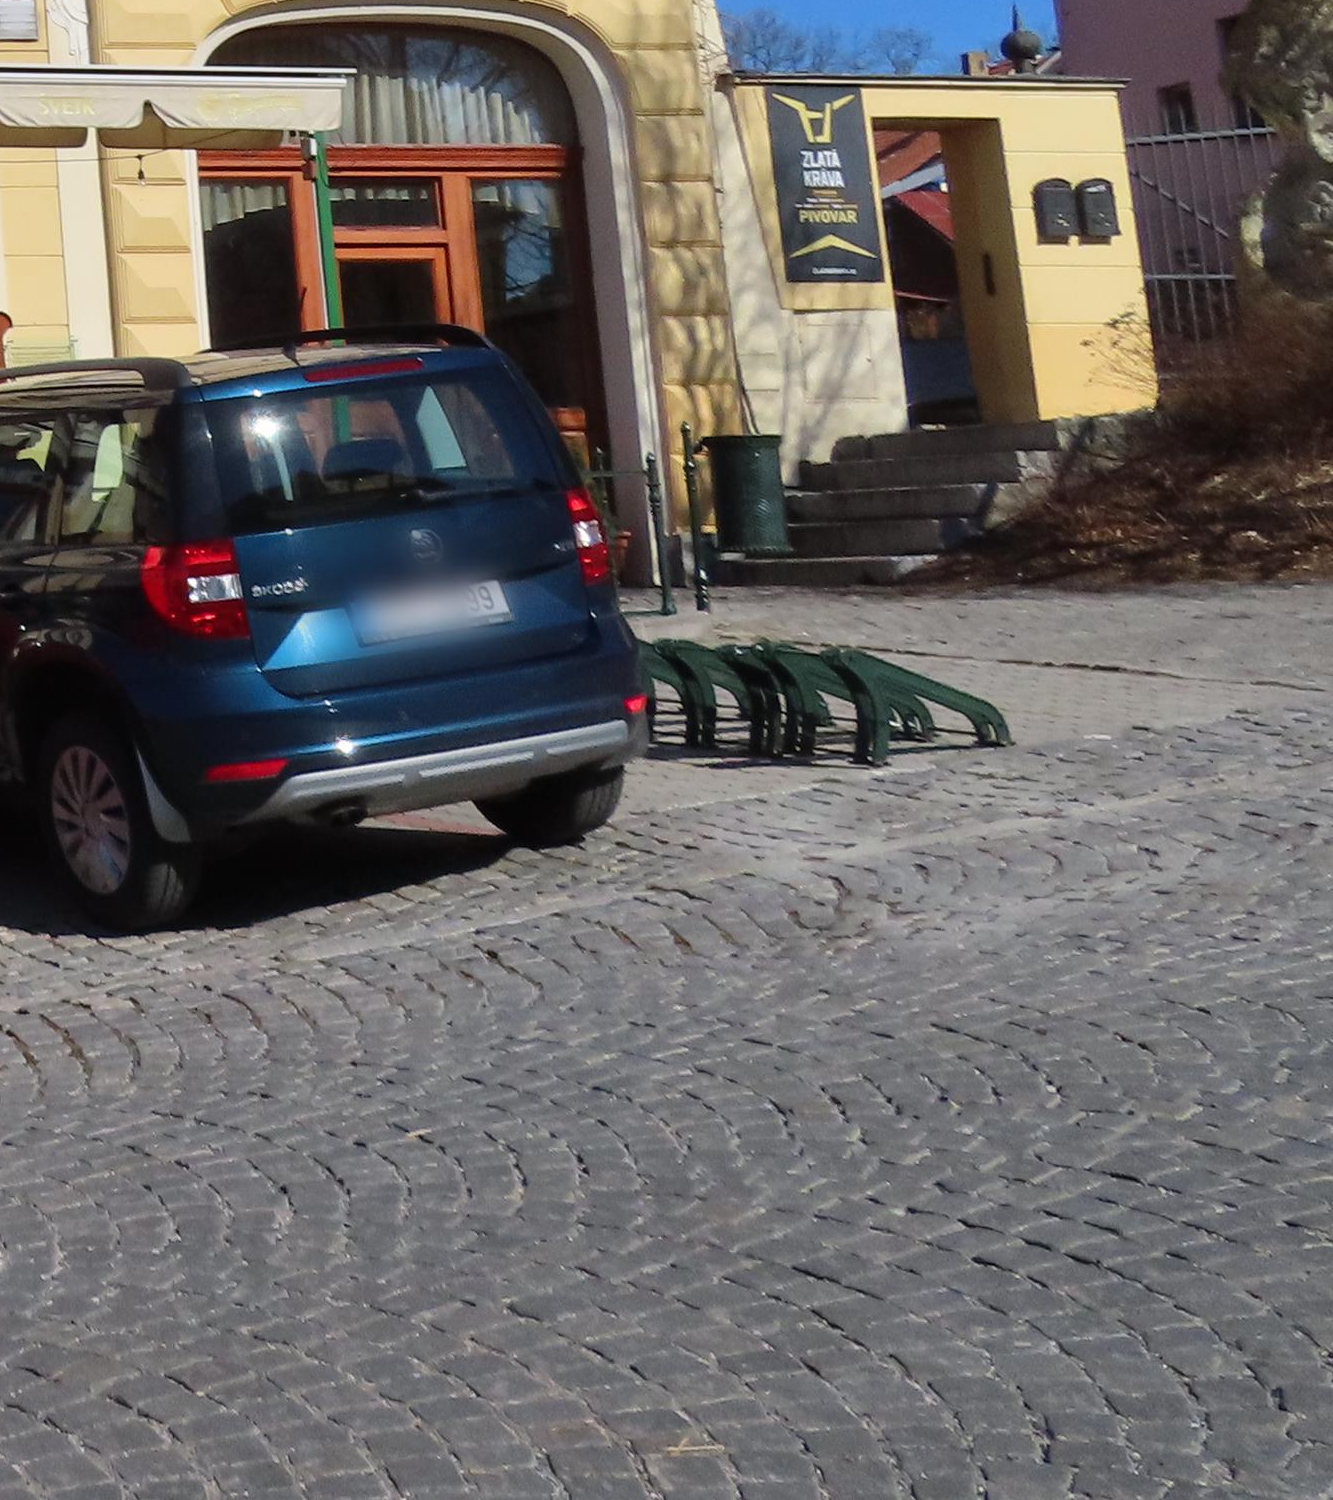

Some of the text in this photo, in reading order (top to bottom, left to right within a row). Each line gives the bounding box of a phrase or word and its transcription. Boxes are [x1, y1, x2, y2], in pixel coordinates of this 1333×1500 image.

[800, 148, 842, 169] ZLATÁ
[802, 168, 846, 189] KRÁVA
[799, 209, 859, 224] PIVOVAR
